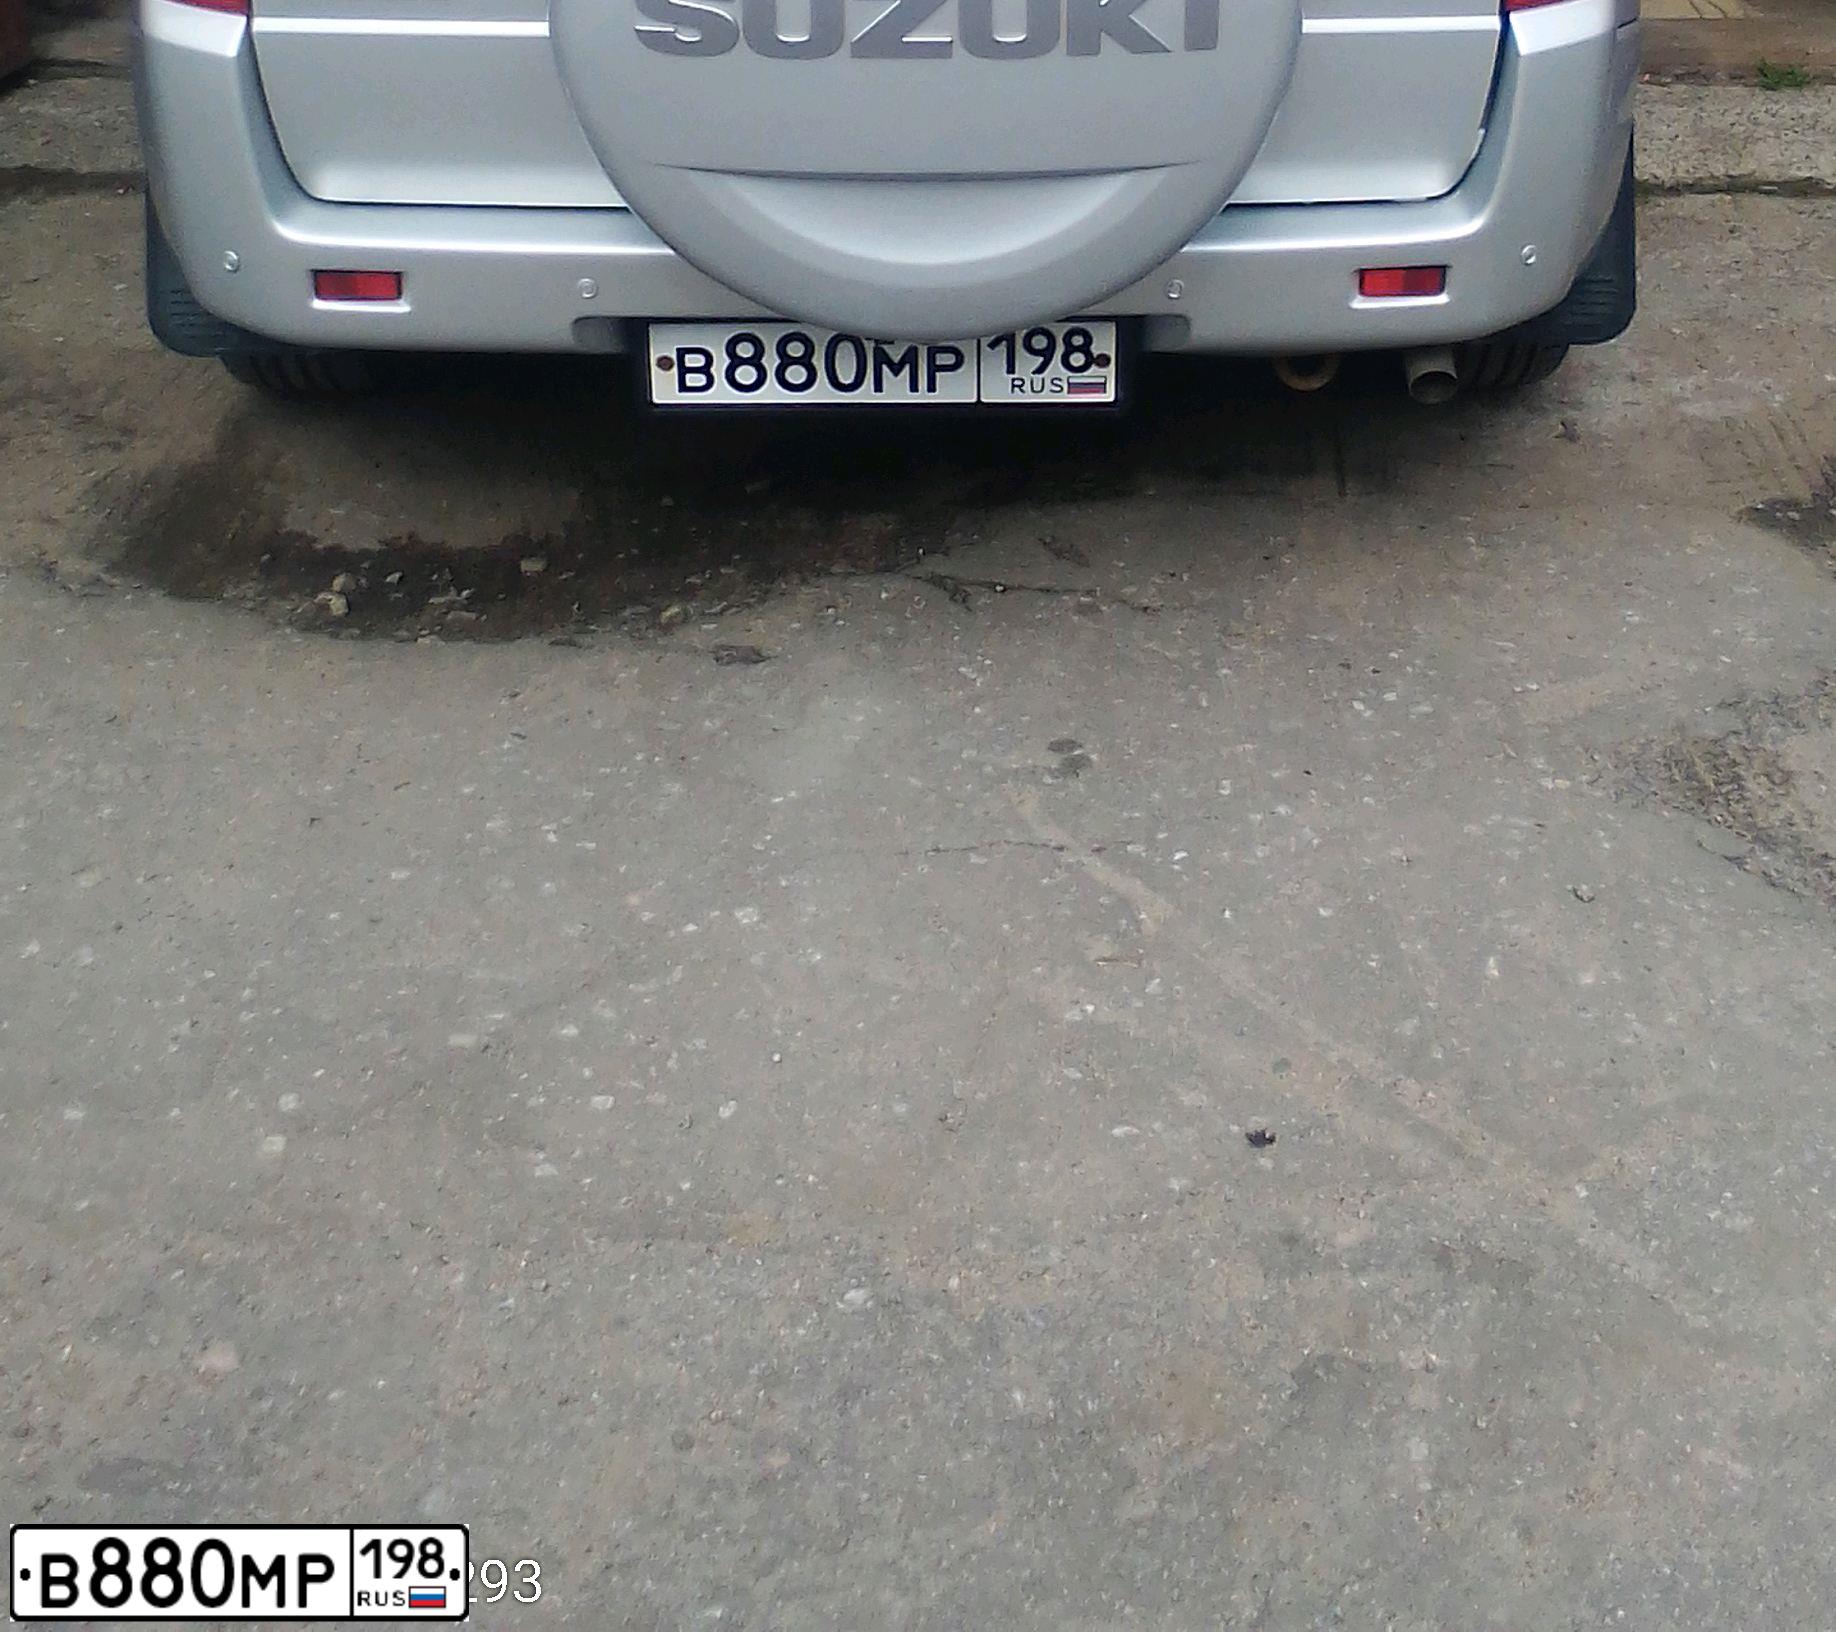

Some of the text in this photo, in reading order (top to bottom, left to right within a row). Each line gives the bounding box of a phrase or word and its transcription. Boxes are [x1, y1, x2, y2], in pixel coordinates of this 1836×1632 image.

[674, 326, 1095, 394] B880MP 198
[1010, 376, 1065, 395] RUS
